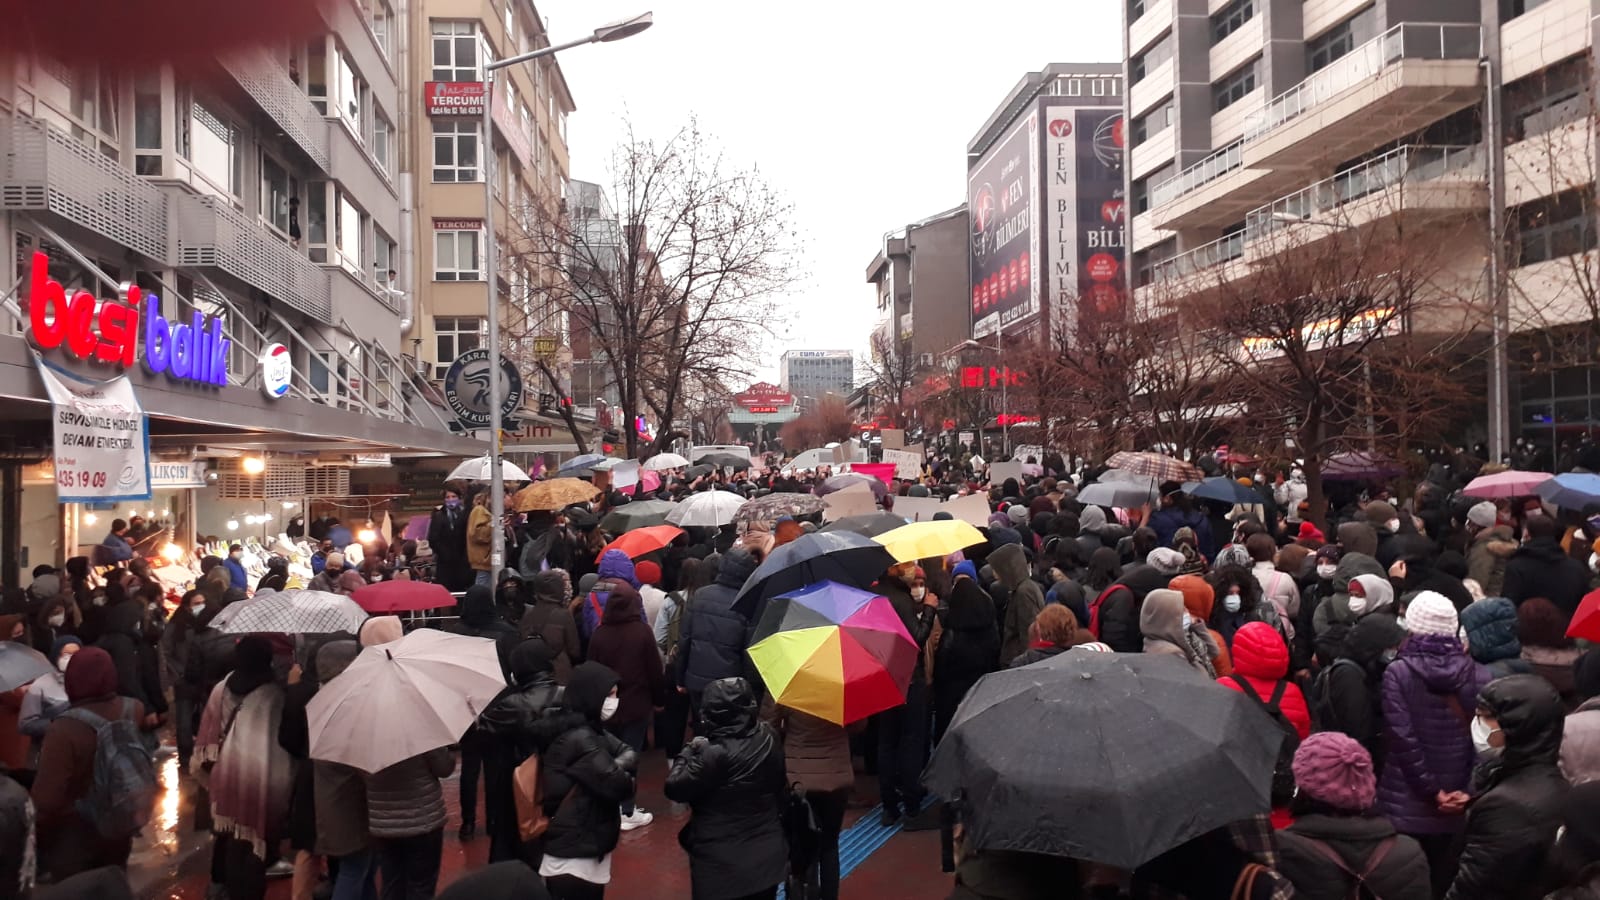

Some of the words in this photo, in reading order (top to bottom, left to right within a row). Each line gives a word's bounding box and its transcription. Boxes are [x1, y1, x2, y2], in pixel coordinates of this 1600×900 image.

[1056, 143, 1067, 185] FEN
[1009, 176, 1024, 206] FEN
[435, 220, 481, 229] TERCÜME
[30, 251, 141, 368] besi
[146, 294, 231, 386] balık
[77, 471, 89, 487] 19
[92, 471, 106, 487] 09
